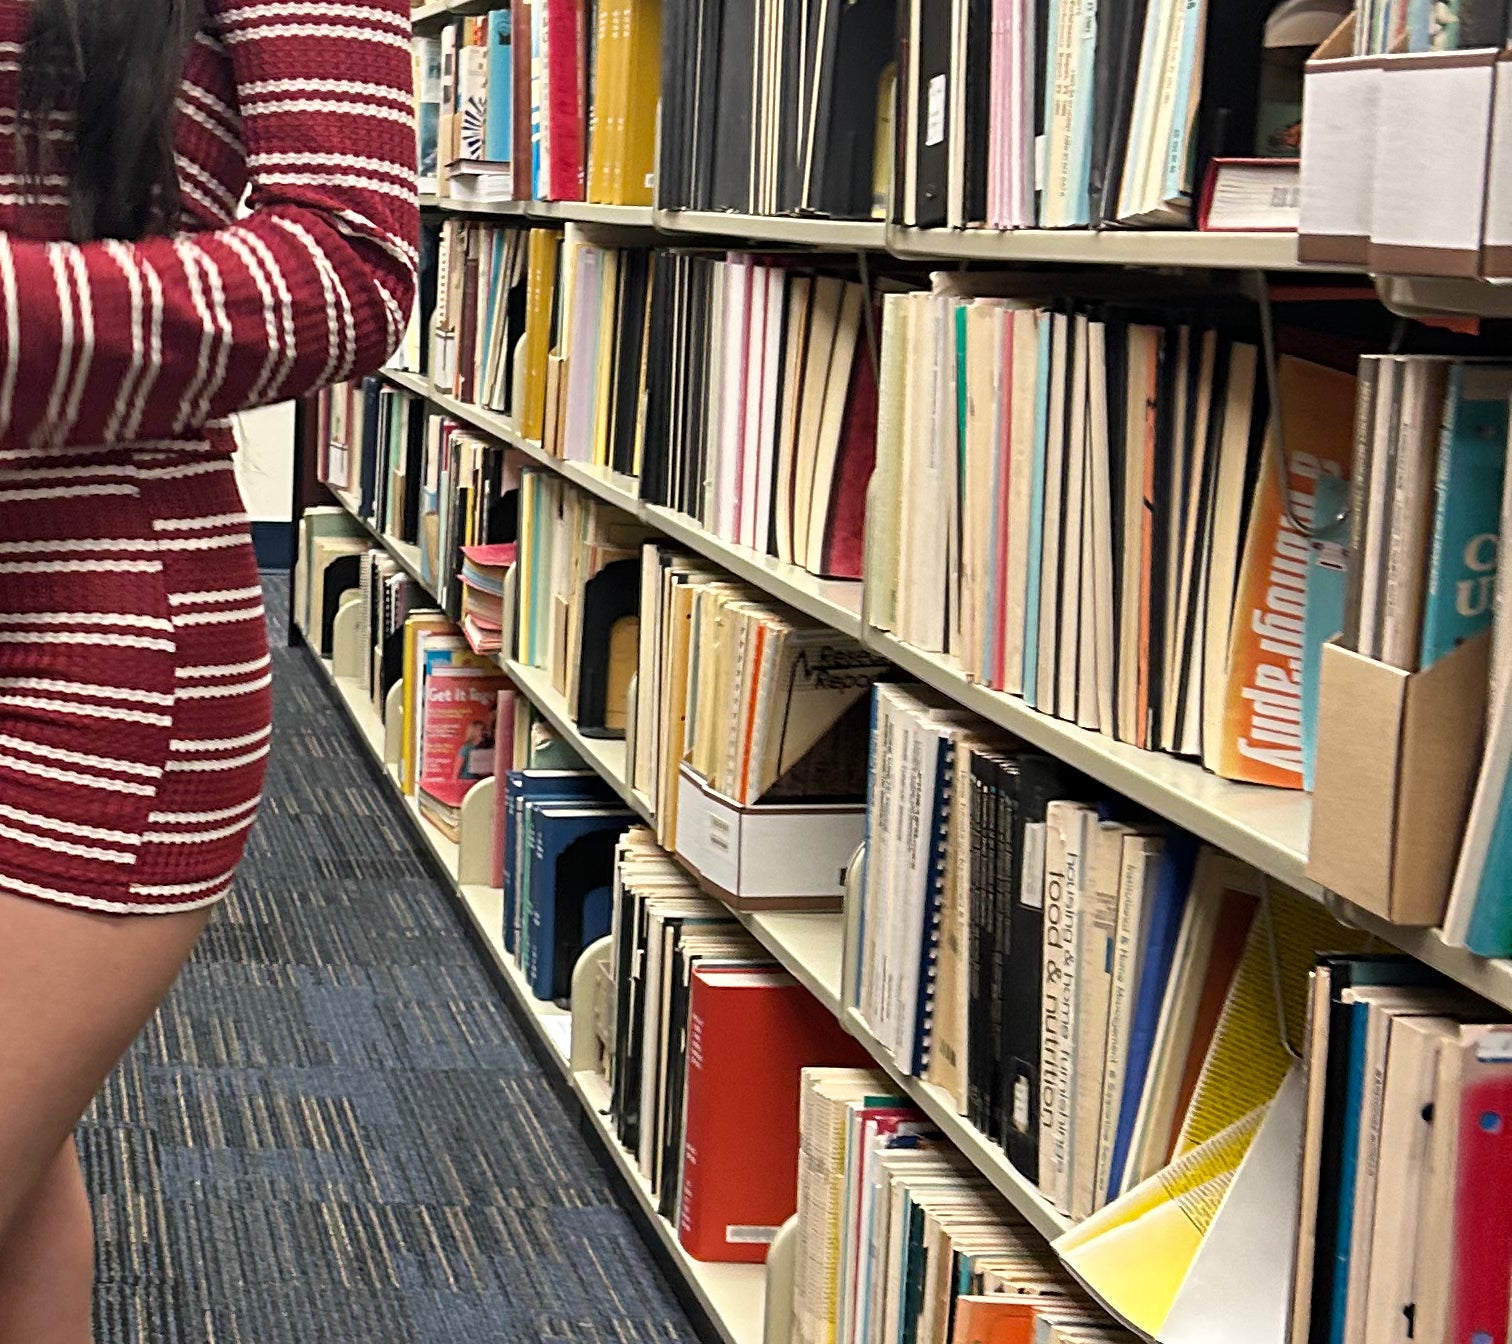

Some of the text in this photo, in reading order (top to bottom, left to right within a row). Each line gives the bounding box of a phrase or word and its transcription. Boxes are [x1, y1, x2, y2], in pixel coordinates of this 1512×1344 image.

[1043, 871, 1065, 1129] food & nutrition
[1056, 852, 1078, 1173] housing & home furnishings
